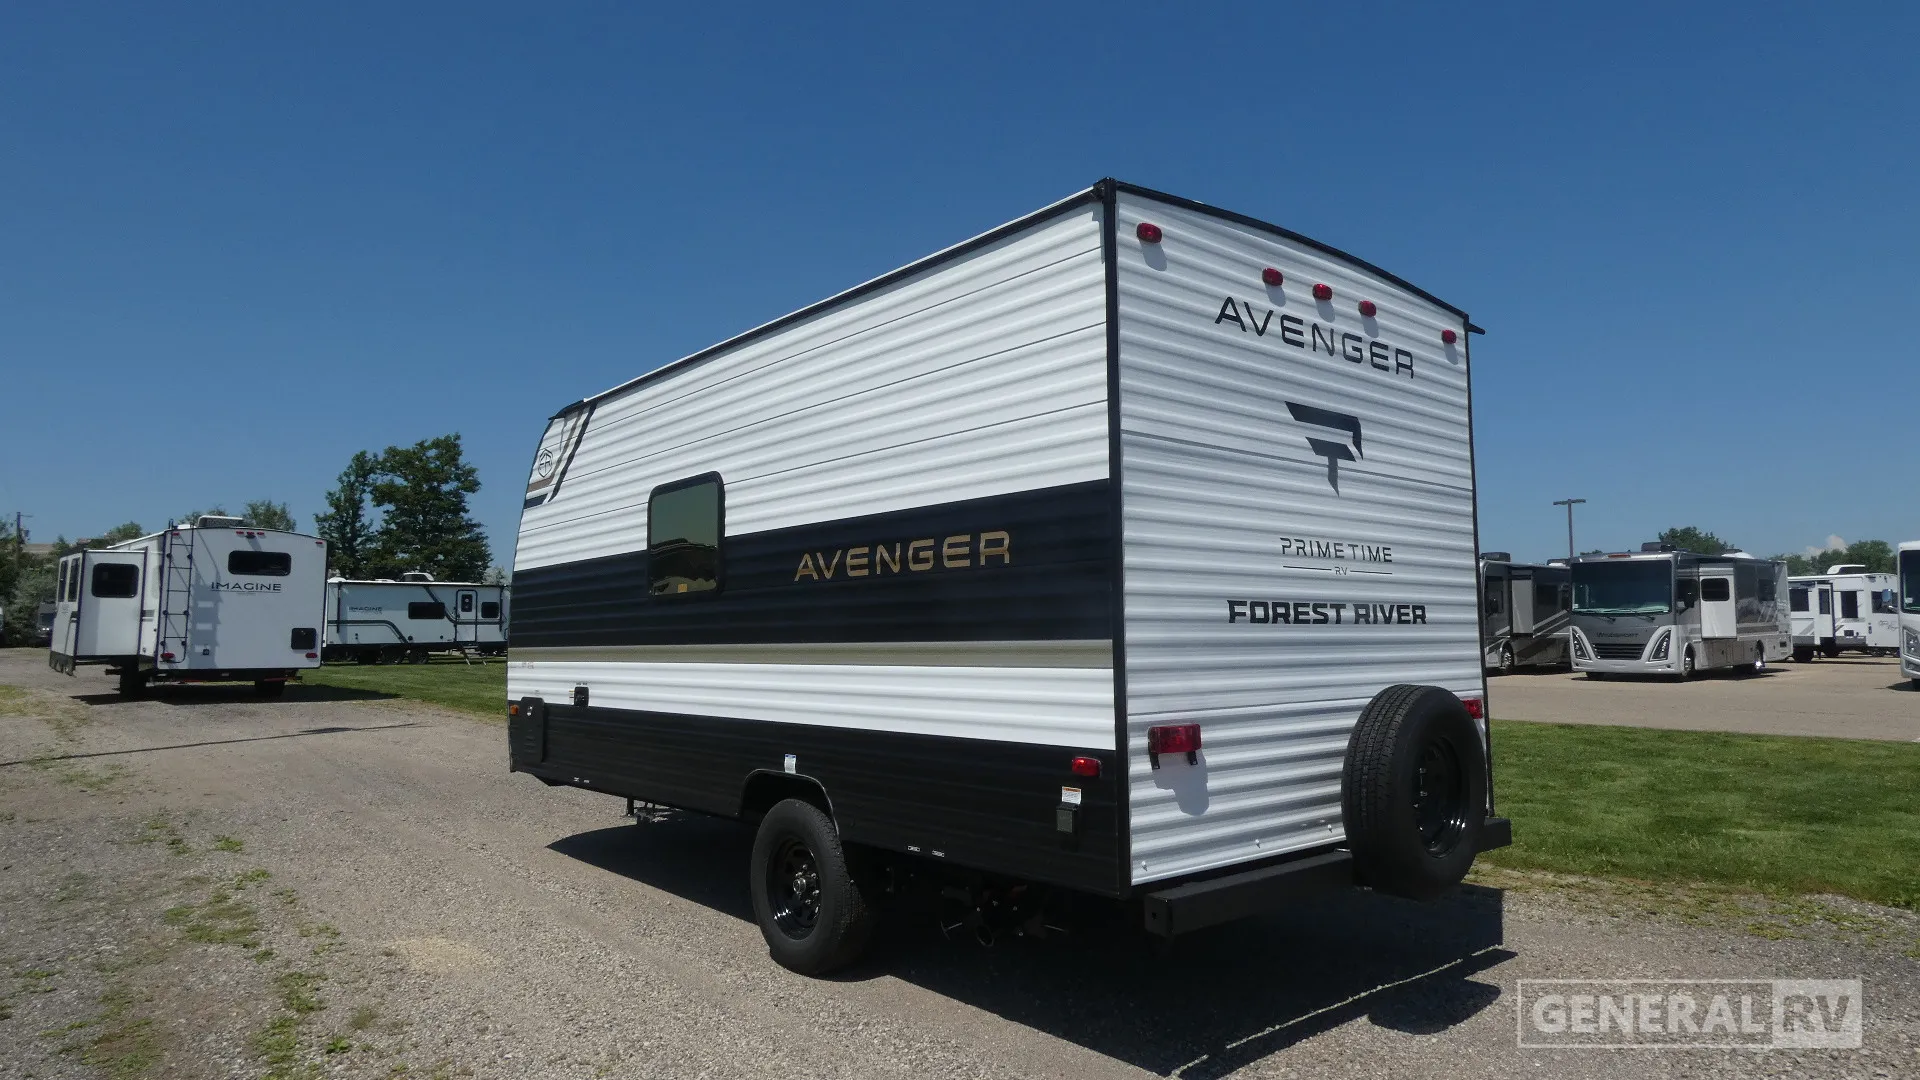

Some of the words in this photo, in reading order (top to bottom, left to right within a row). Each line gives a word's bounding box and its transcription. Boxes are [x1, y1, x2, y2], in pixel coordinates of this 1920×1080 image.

[1215, 296, 1414, 379] AVENGER
[794, 530, 1010, 582] AVENGER
[1334, 566, 1348, 576] RV
[210, 581, 282, 591] IMAGINE
[1227, 600, 1347, 625] FOREST
[1353, 603, 1427, 625] RIVER
